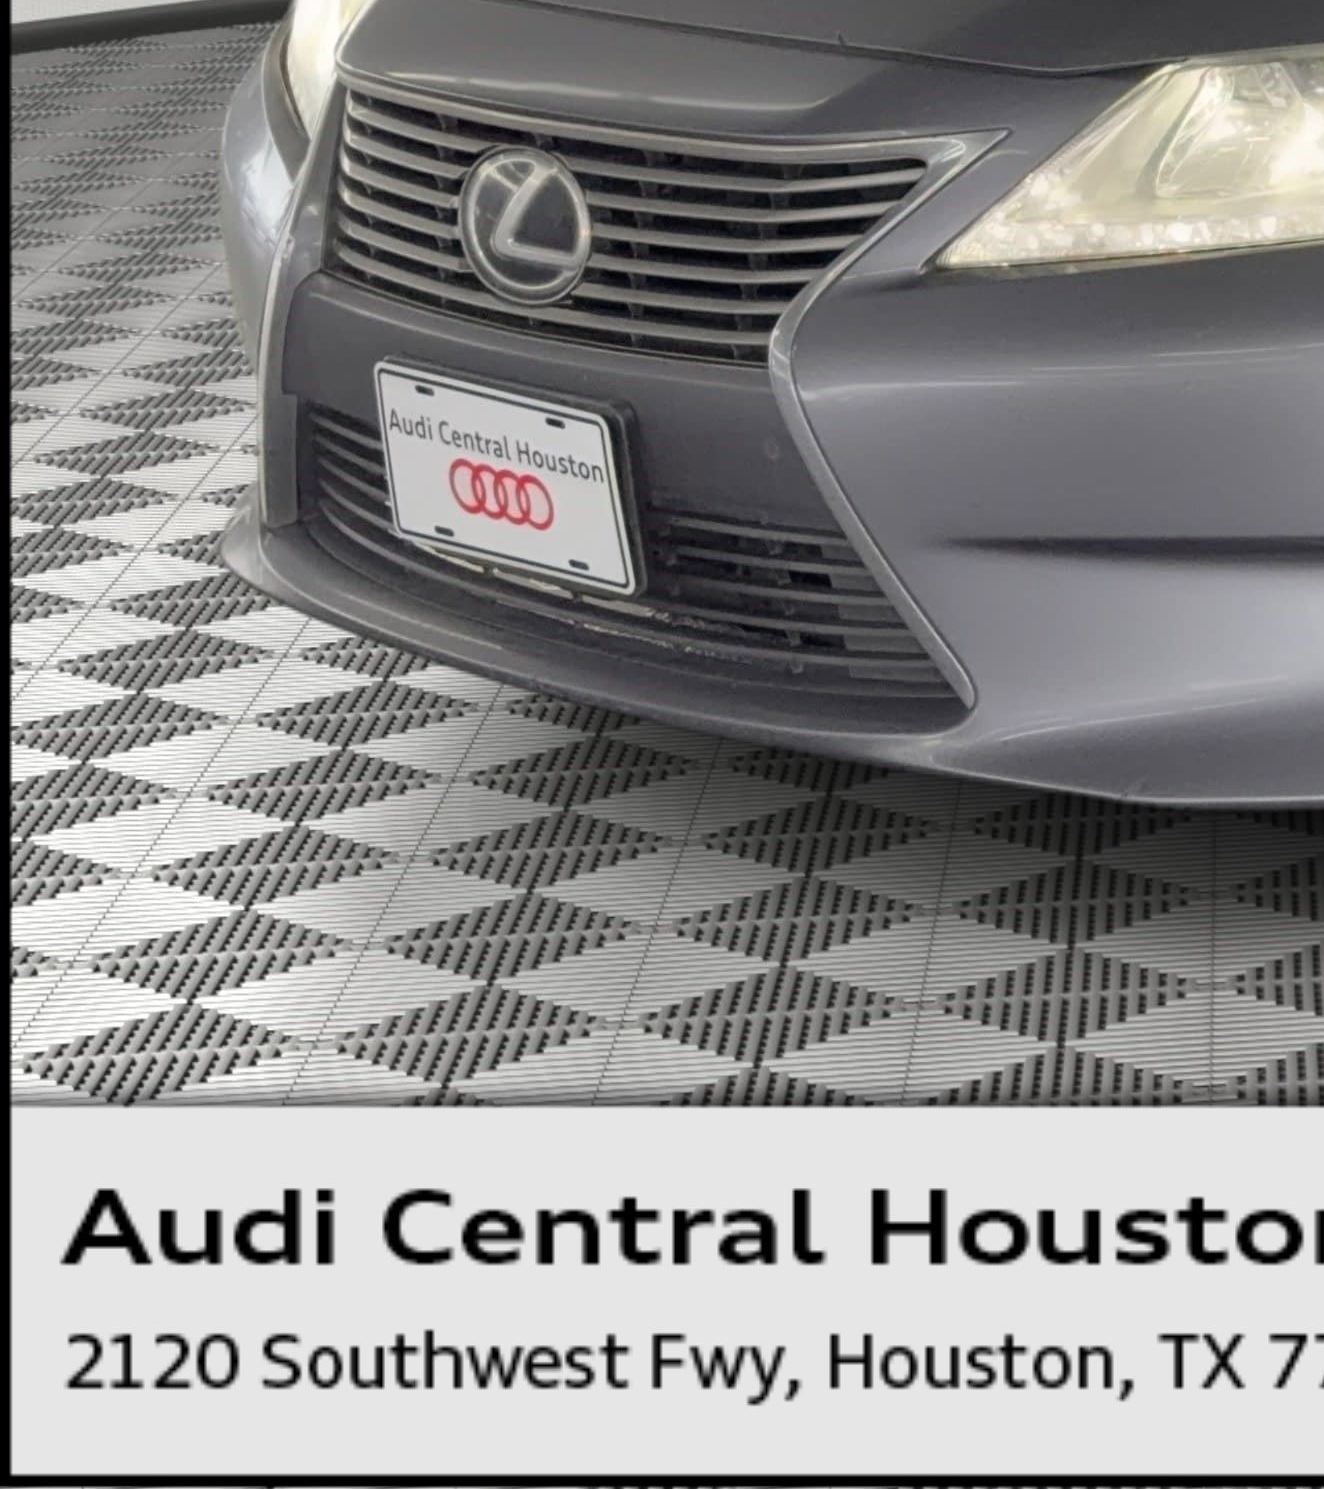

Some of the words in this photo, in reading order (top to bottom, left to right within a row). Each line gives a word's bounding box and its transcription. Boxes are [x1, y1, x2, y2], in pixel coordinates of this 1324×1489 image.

[389, 407, 433, 441] Audi
[438, 420, 512, 462] Central
[516, 440, 605, 484] Houston
